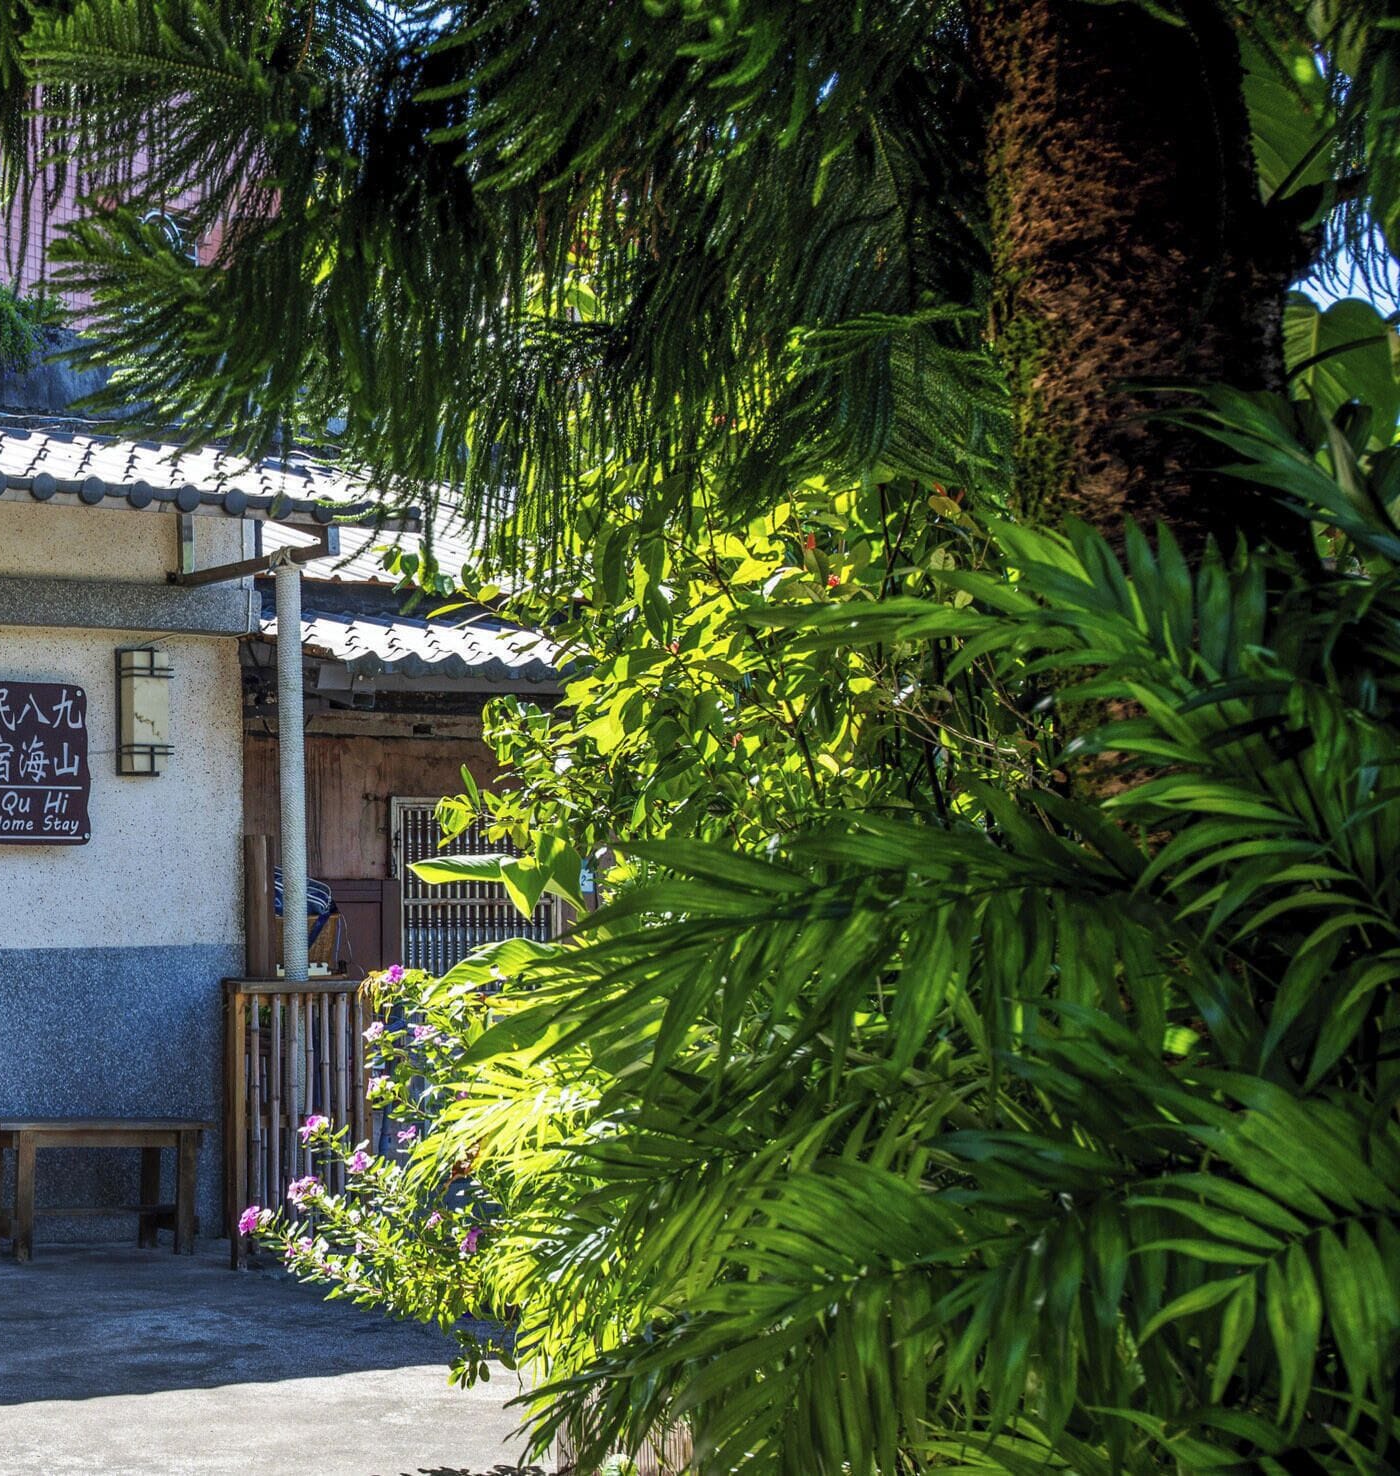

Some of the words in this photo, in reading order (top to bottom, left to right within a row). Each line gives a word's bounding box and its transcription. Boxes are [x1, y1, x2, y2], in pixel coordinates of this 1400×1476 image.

[17, 693, 51, 783] 八海
[52, 689, 83, 776] 九山
[1, 791, 31, 816] Qu
[43, 791, 69, 814] Hi
[43, 815, 80, 835] Stay
